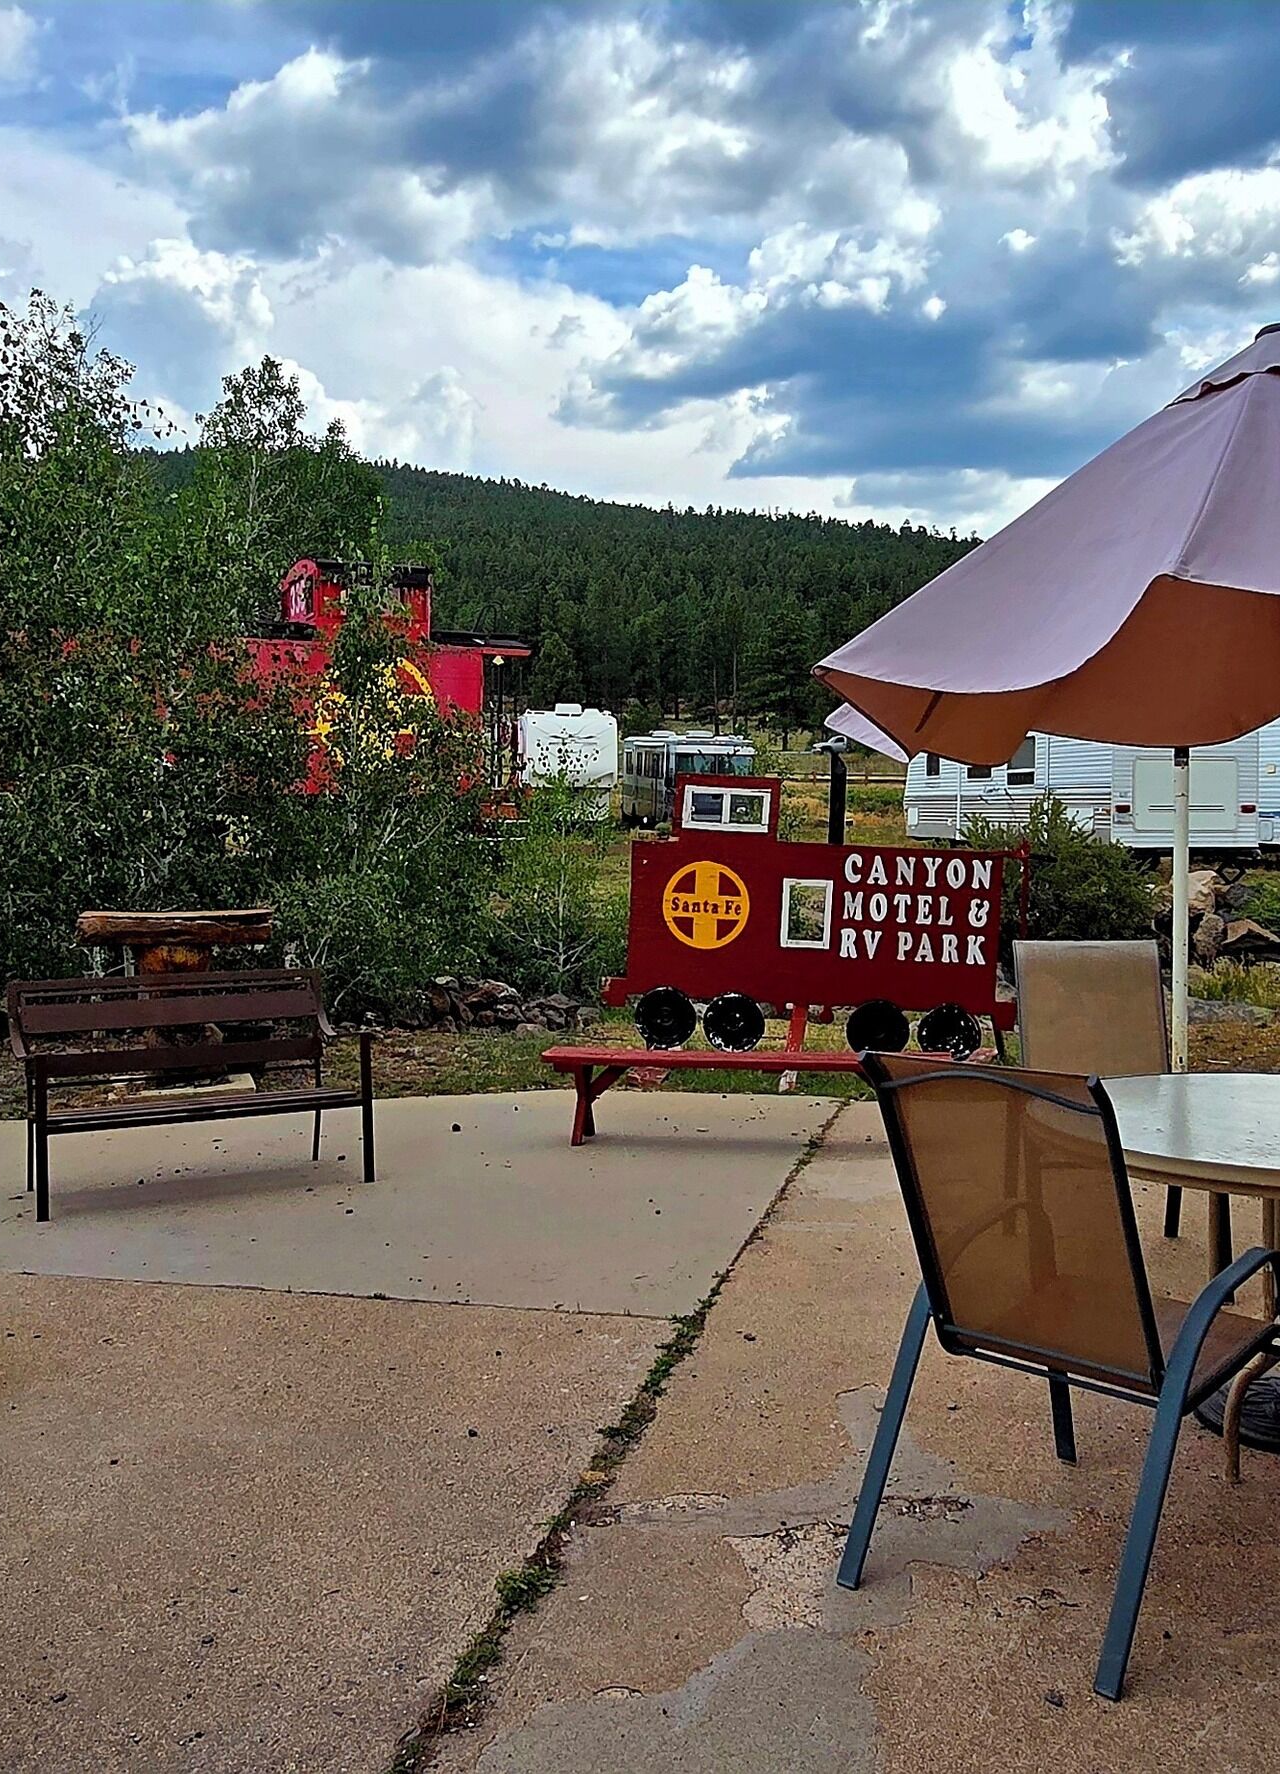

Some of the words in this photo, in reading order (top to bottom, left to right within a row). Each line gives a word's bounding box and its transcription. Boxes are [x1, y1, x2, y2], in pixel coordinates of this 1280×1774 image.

[844, 853, 993, 890] CANYON
[671, 896, 719, 914] Santa
[724, 899, 742, 916] Fe
[842, 890, 954, 926] MOTEL
[967, 898, 990, 928] &
[839, 927, 883, 960] RV
[896, 931, 986, 965] PARK
